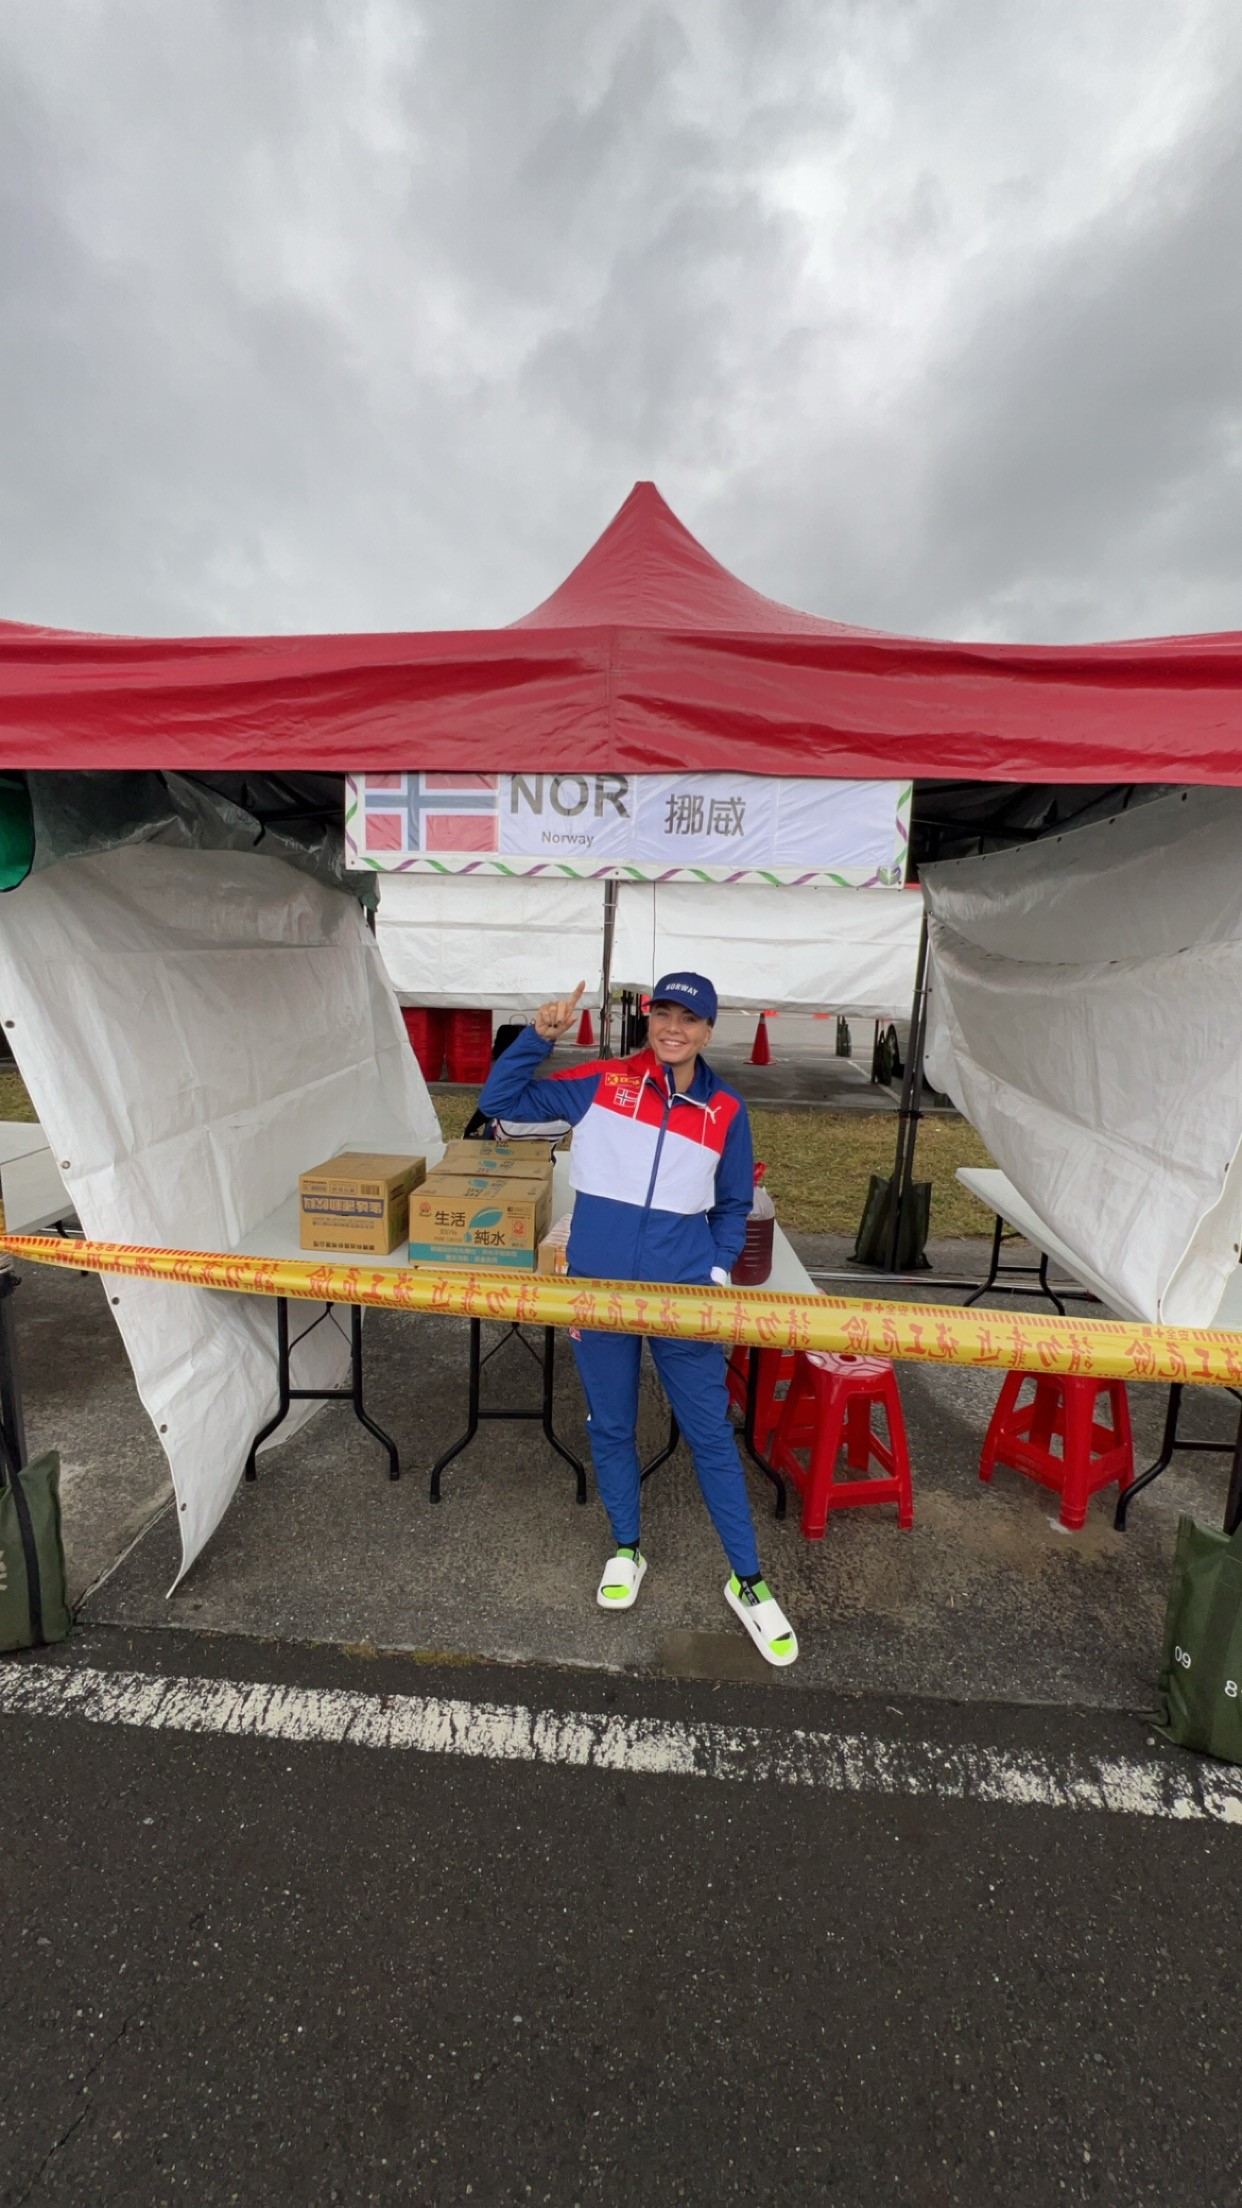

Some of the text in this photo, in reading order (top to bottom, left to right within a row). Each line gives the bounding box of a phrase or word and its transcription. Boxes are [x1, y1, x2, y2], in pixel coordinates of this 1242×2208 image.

[510, 773, 630, 818] NOR
[664, 794, 746, 837] 挪威
[541, 830, 595, 848] Norway
[665, 982, 699, 996] NORWAY
[434, 1211, 466, 1228] 生活
[474, 1230, 505, 1246] 純水
